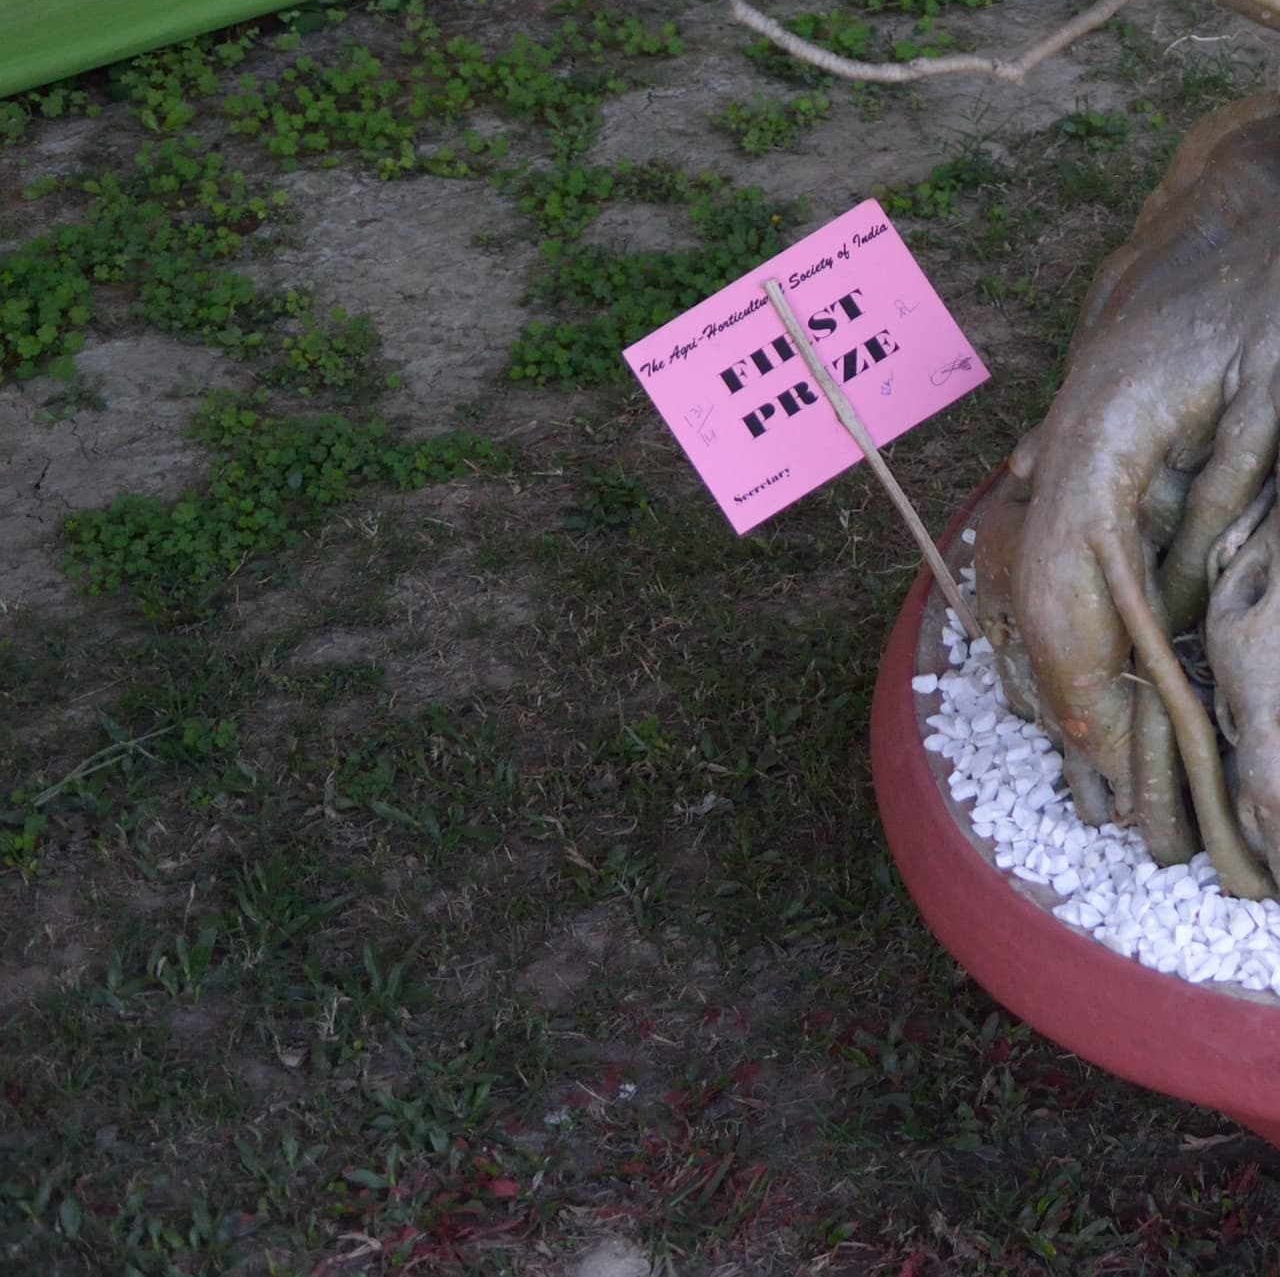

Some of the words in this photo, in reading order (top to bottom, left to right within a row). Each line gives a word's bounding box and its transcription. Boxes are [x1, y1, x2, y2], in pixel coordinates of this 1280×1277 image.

[639, 358, 666, 378] The
[788, 254, 834, 290] Society
[837, 244, 850, 260] of
[852, 222, 889, 249] India
[741, 328, 901, 440] PRZE
[732, 468, 792, 505] Secretary
